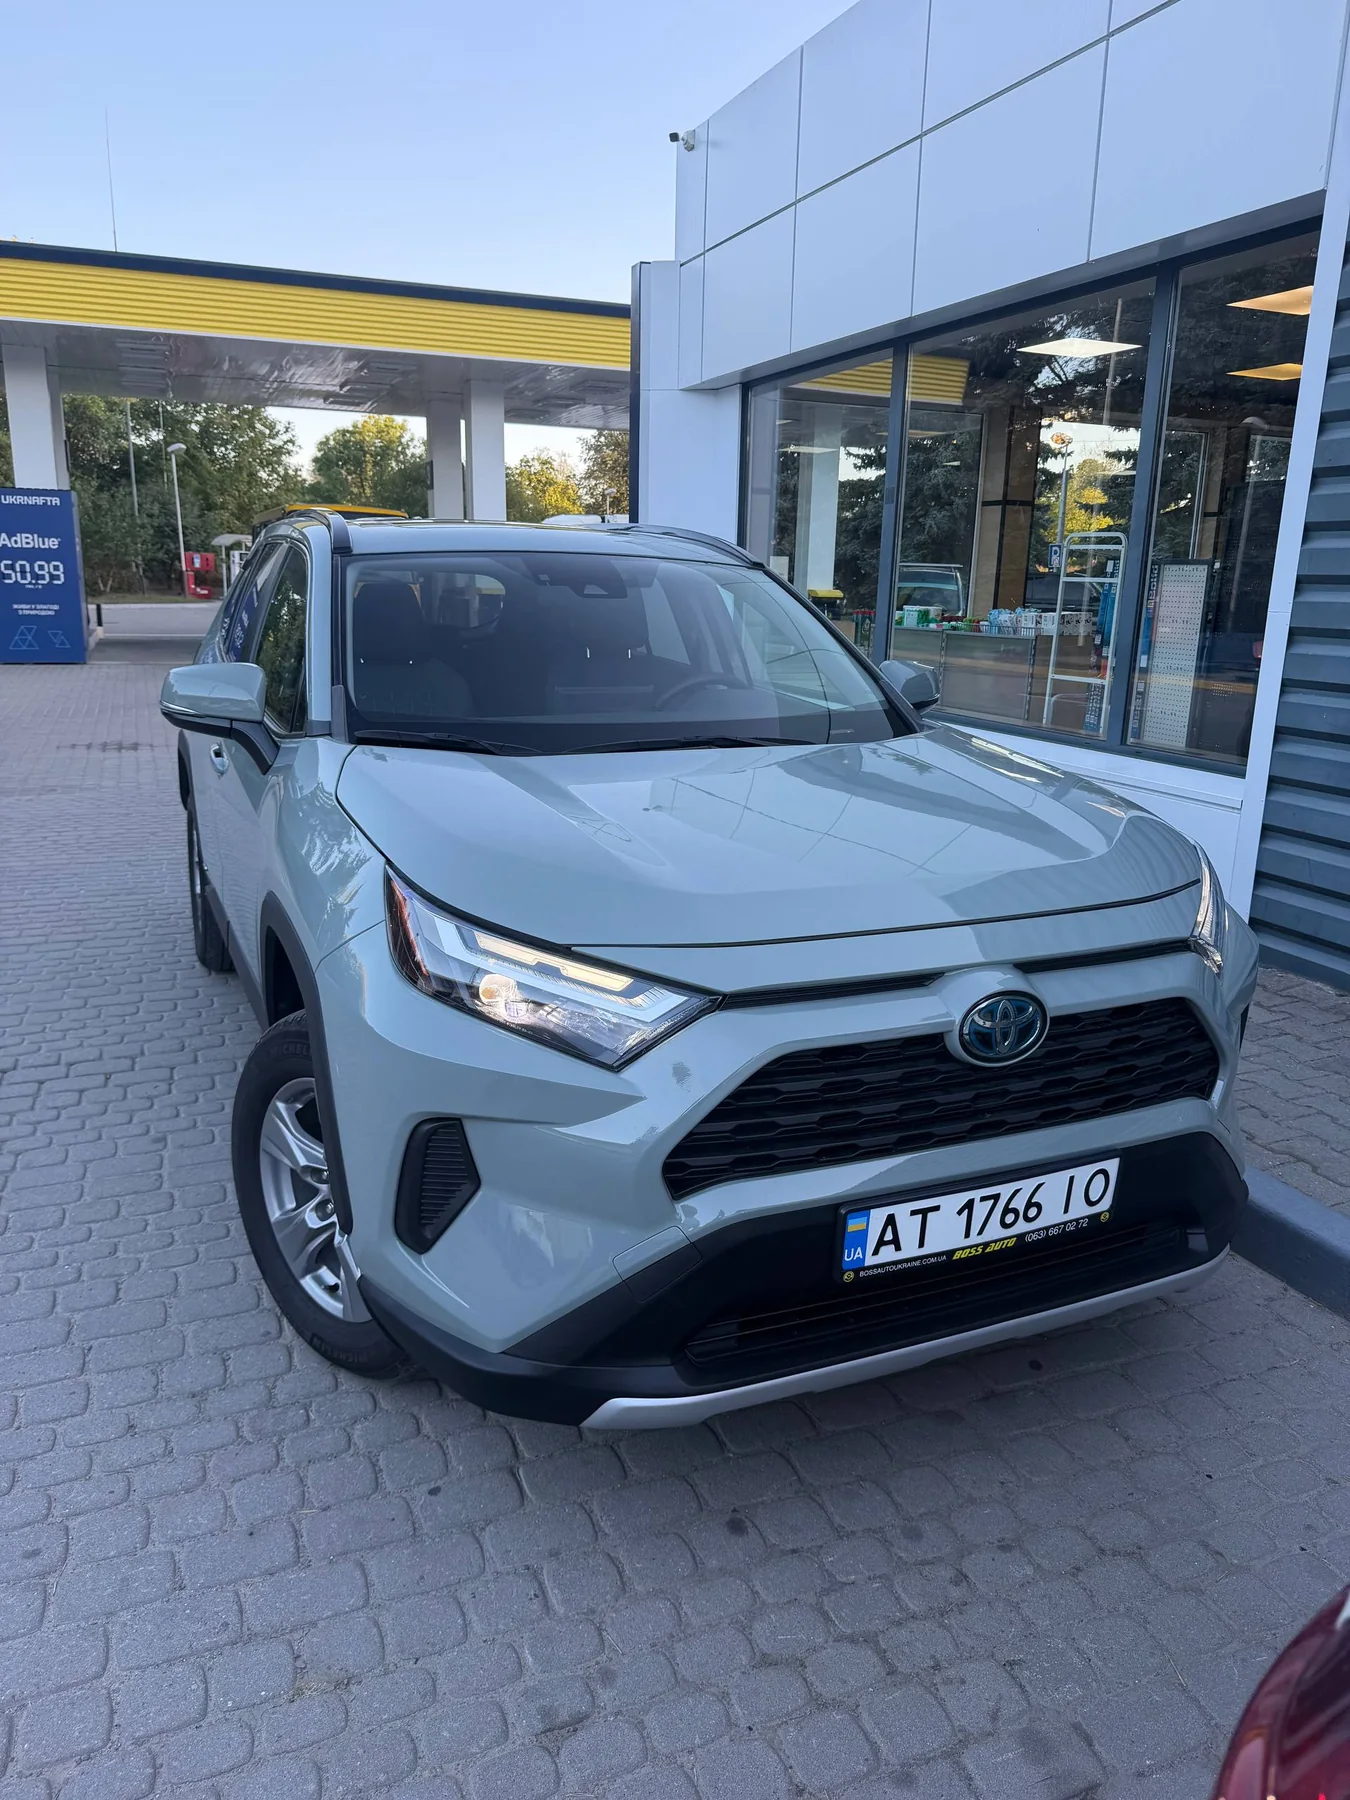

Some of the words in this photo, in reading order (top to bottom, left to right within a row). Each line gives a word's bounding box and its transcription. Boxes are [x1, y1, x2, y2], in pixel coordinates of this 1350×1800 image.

[1, 495, 60, 506] UKRNAFTA
[0, 560, 65, 585] 50.99
[871, 1204, 941, 1257] AT
[956, 1181, 1046, 1240] 1766
[1063, 1168, 1110, 1215] IO
[844, 1246, 863, 1261] UA
[859, 1254, 947, 1277] BOSSAUTOUKRAINE.COM.UA
[952, 1245, 984, 1261] BOSS
[985, 1237, 1017, 1253] AUTO
[1025, 1229, 1047, 1242] (063)
[1048, 1225, 1064, 1236] 667
[1065, 1221, 1076, 1232] 02
[1078, 1218, 1089, 1228] 72
